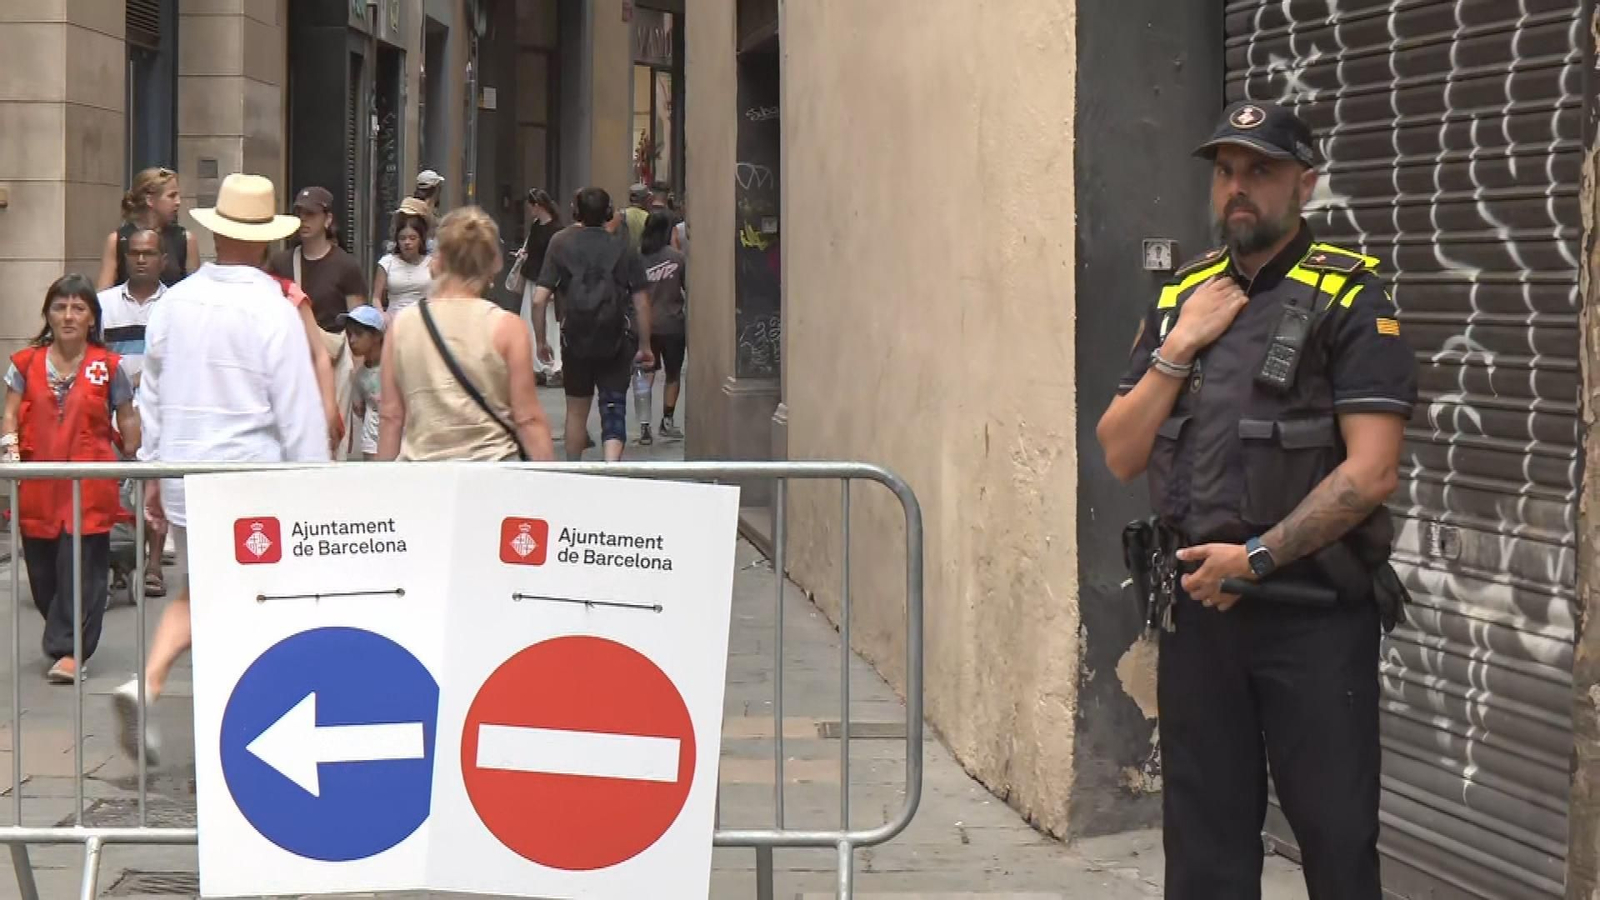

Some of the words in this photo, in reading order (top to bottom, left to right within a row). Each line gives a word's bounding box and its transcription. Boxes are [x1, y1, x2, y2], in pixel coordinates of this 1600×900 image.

[291, 518, 396, 541] Ajuntament
[558, 527, 664, 550] Ajuntament
[293, 541, 314, 556] de
[318, 538, 407, 556] Barcelona
[557, 547, 579, 564] de
[583, 549, 673, 571] Barcelona
